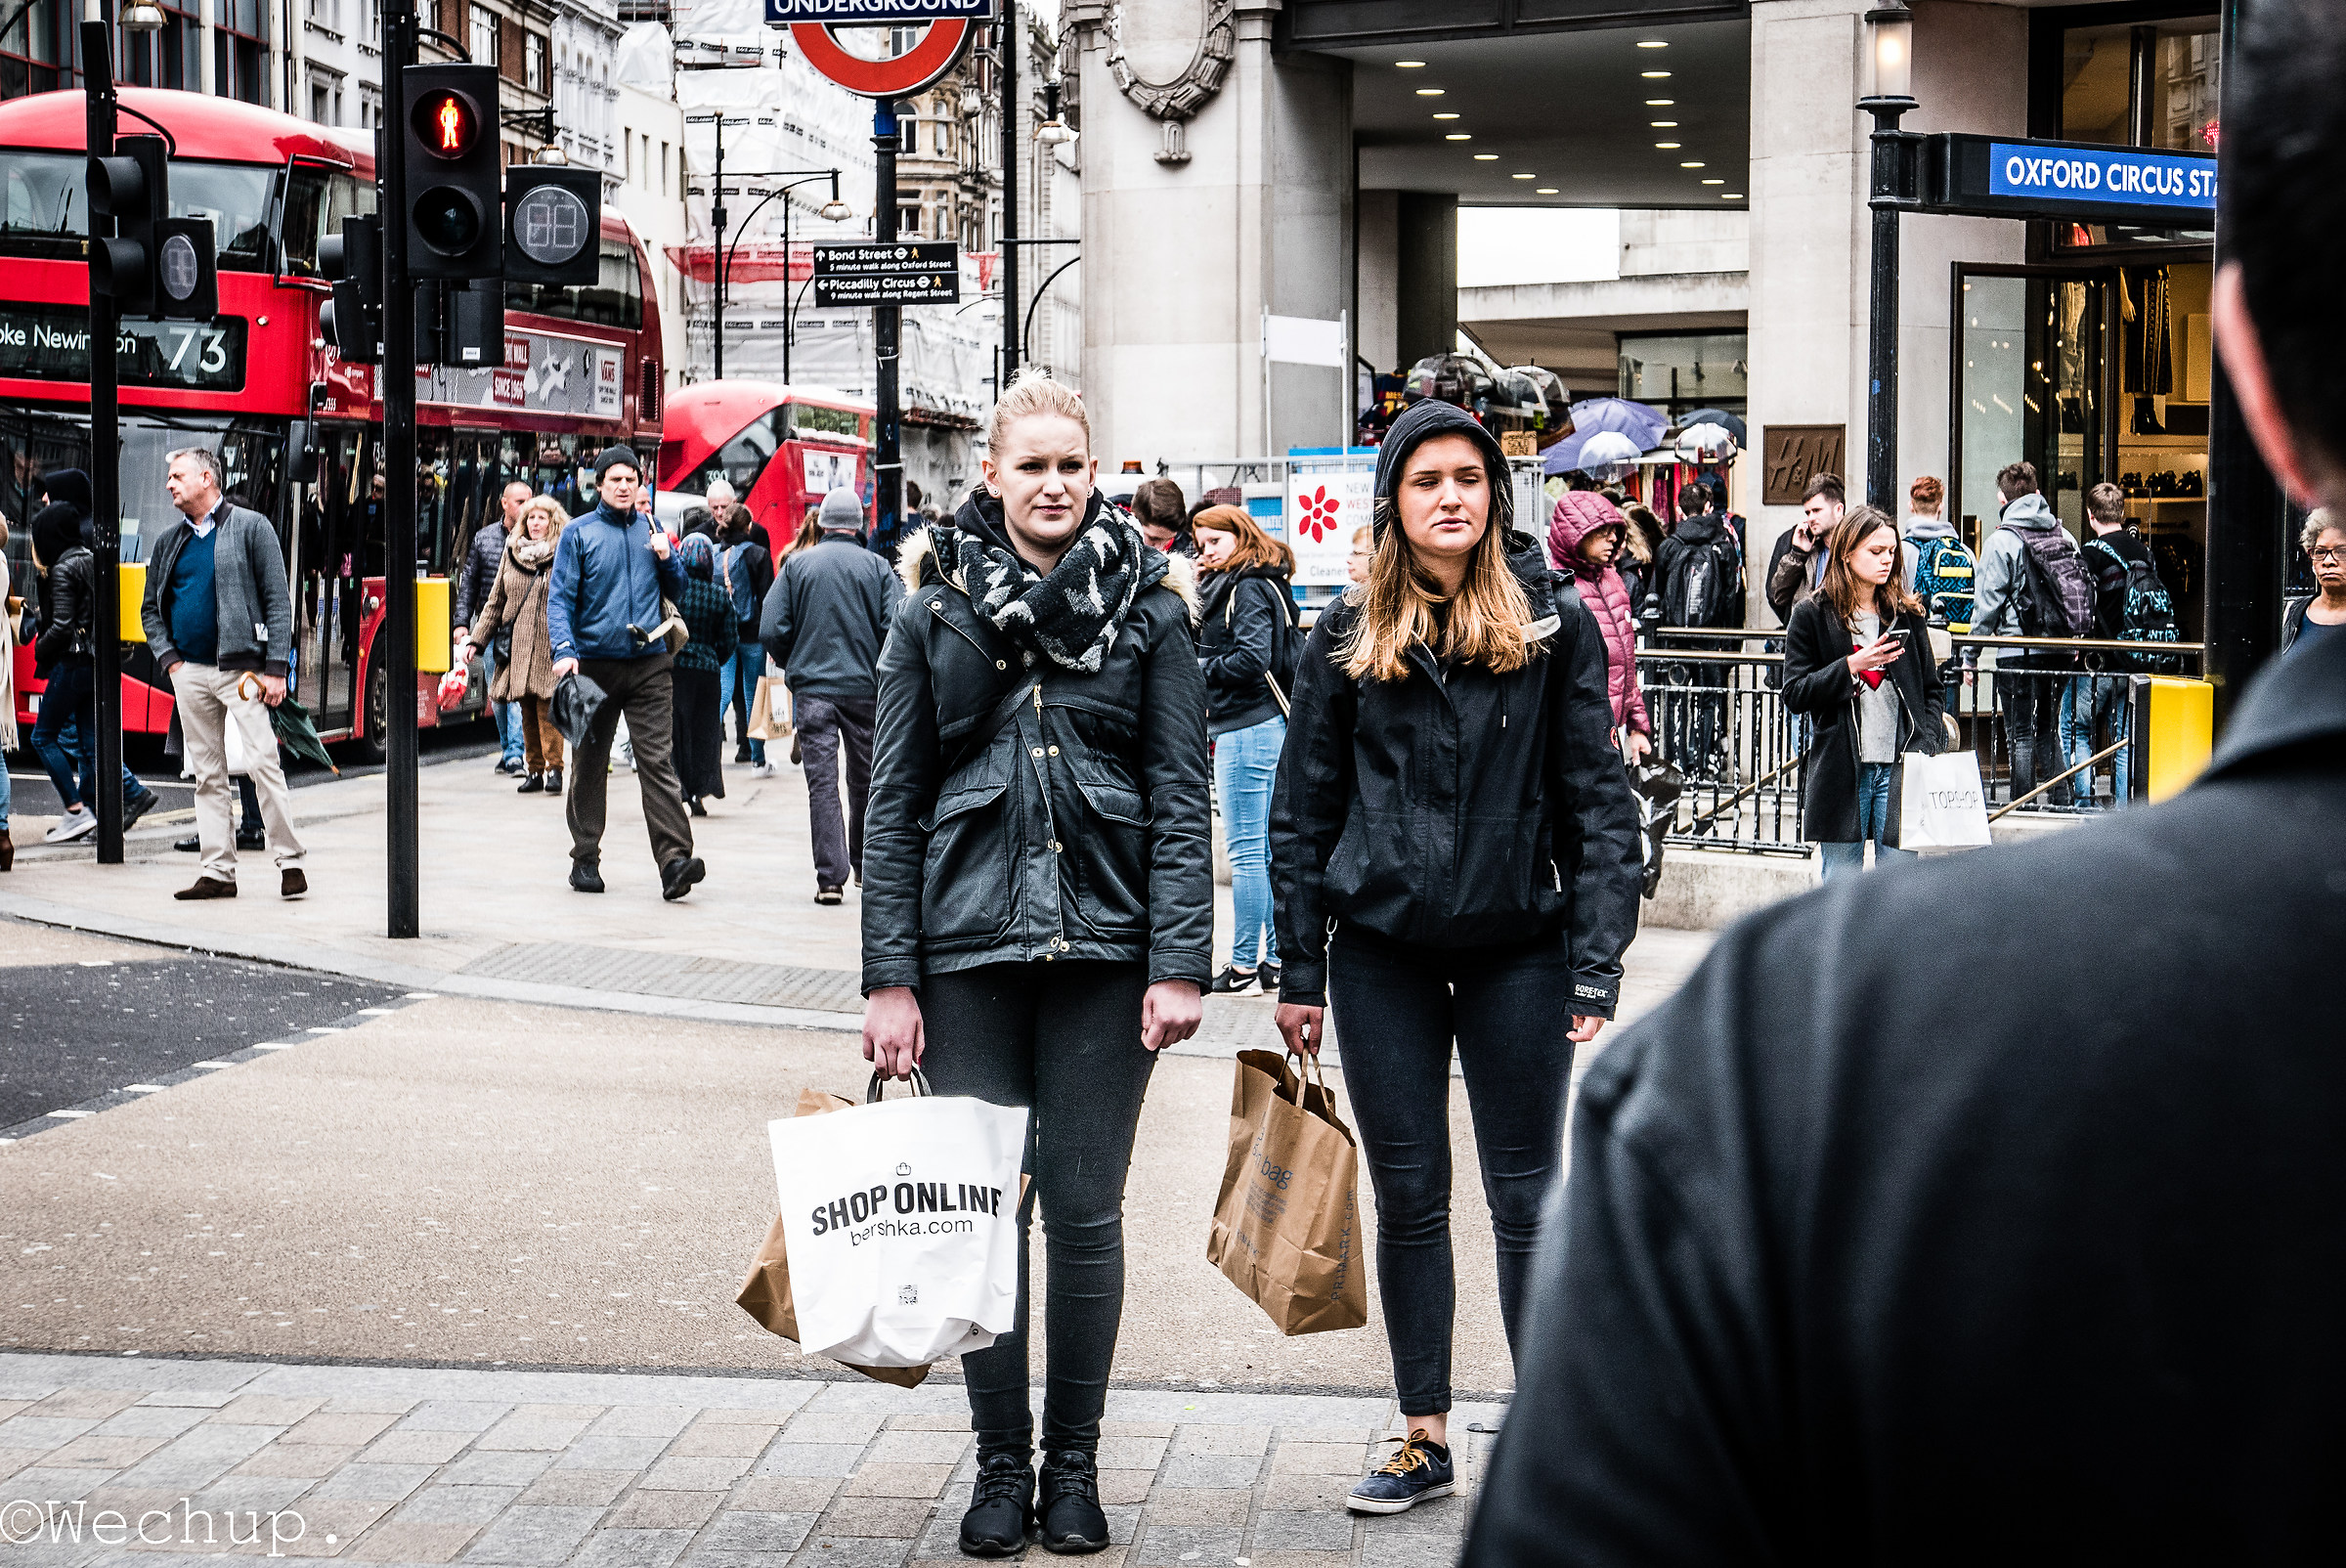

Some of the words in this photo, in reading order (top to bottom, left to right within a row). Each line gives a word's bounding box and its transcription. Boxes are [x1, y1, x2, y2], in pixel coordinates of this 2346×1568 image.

[2006, 155, 2101, 190] OXFORD
[2106, 162, 2185, 196] CIRCUS
[828, 249, 856, 261] Bond
[858, 248, 892, 260] Street
[836, 263, 861, 272] minute
[881, 262, 900, 271] along
[901, 261, 928, 270] Oxford
[929, 260, 952, 269] Street
[829, 278, 880, 290] Piccadilly
[882, 278, 916, 289] Circus
[837, 291, 863, 300] minute
[864, 290, 881, 299] walk
[882, 290, 902, 299] along
[902, 289, 929, 299] Regent
[930, 288, 953, 297] Street
[168, 326, 228, 373] 73
[1345, 482, 1370, 495] NEW
[1260, 1155, 1294, 1191] bag
[810, 1184, 888, 1237] SHOP
[849, 1219, 974, 1247] bershka.com
